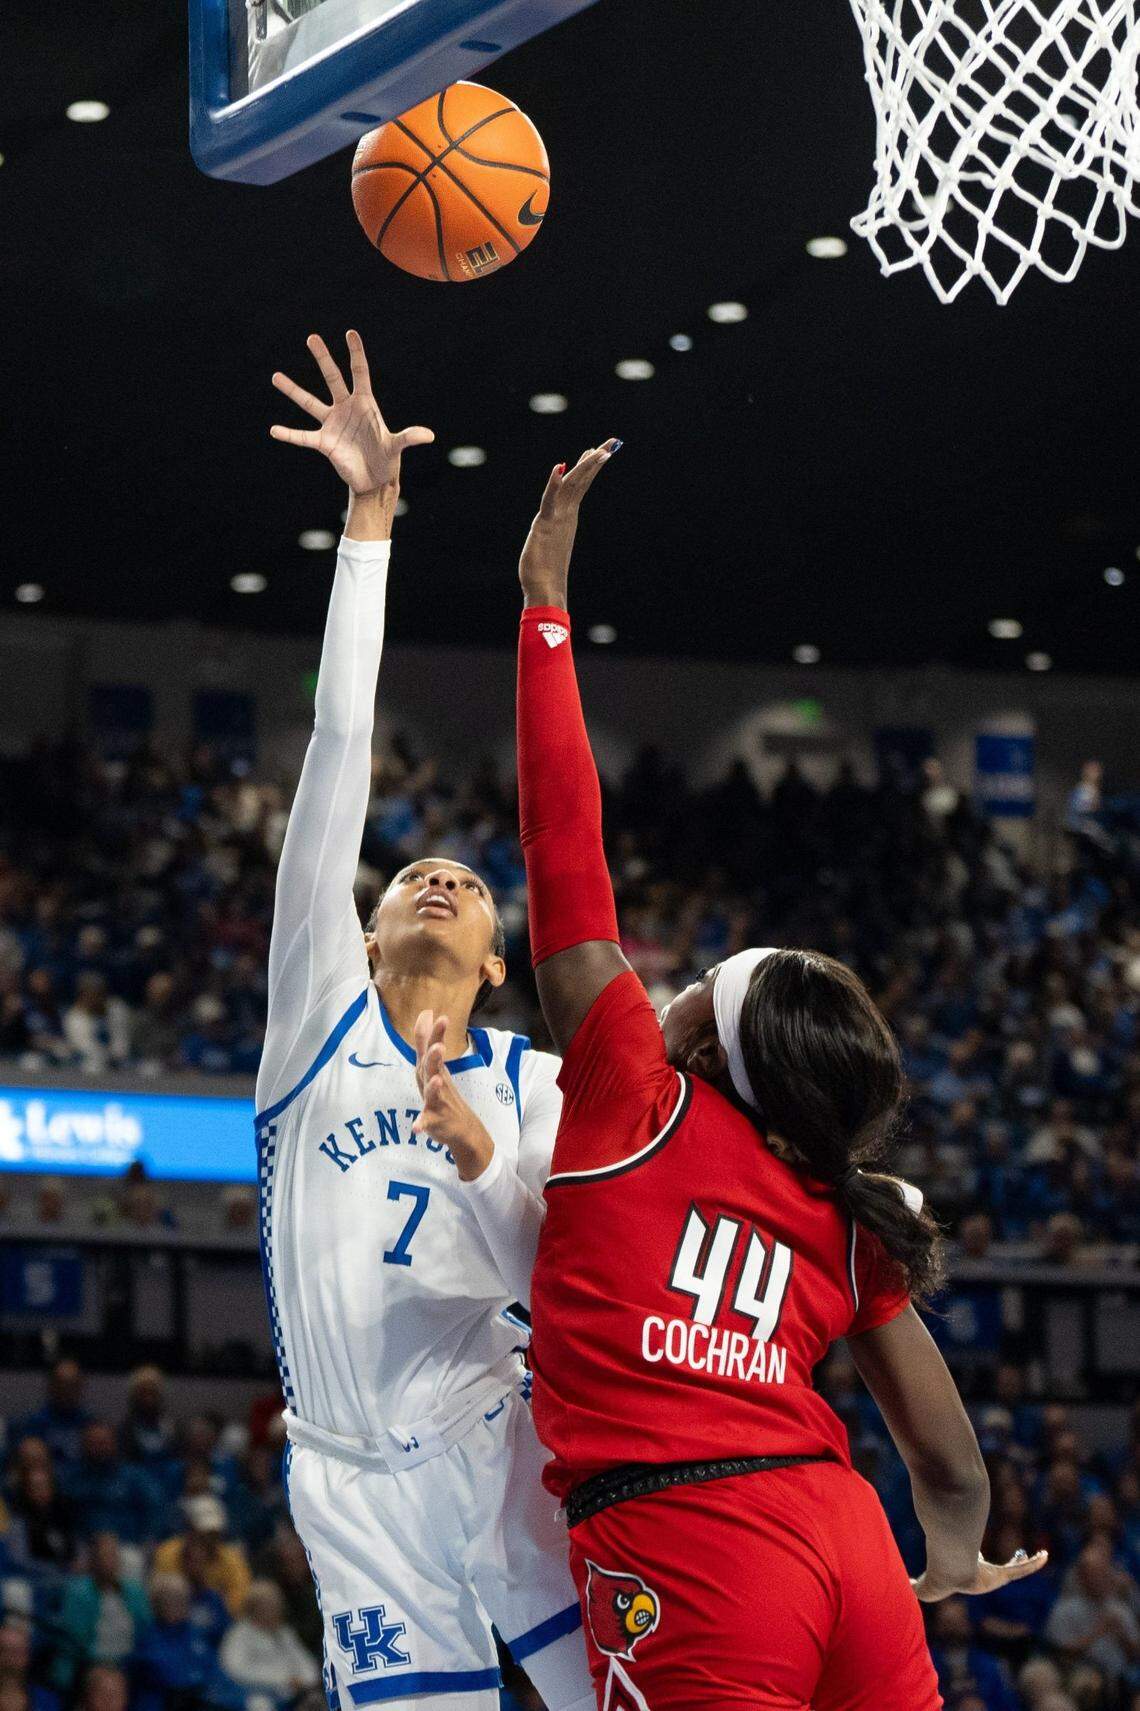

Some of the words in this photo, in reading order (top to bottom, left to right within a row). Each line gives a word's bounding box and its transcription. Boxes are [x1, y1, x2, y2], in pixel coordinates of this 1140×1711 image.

[496, 1083, 515, 1105] SEC
[318, 1108, 457, 1173] KENT
[383, 1180, 430, 1266] 7
[666, 1200, 794, 1342] 44
[641, 1315, 787, 1384] COCHRAN
[332, 1604, 411, 1674] UK
